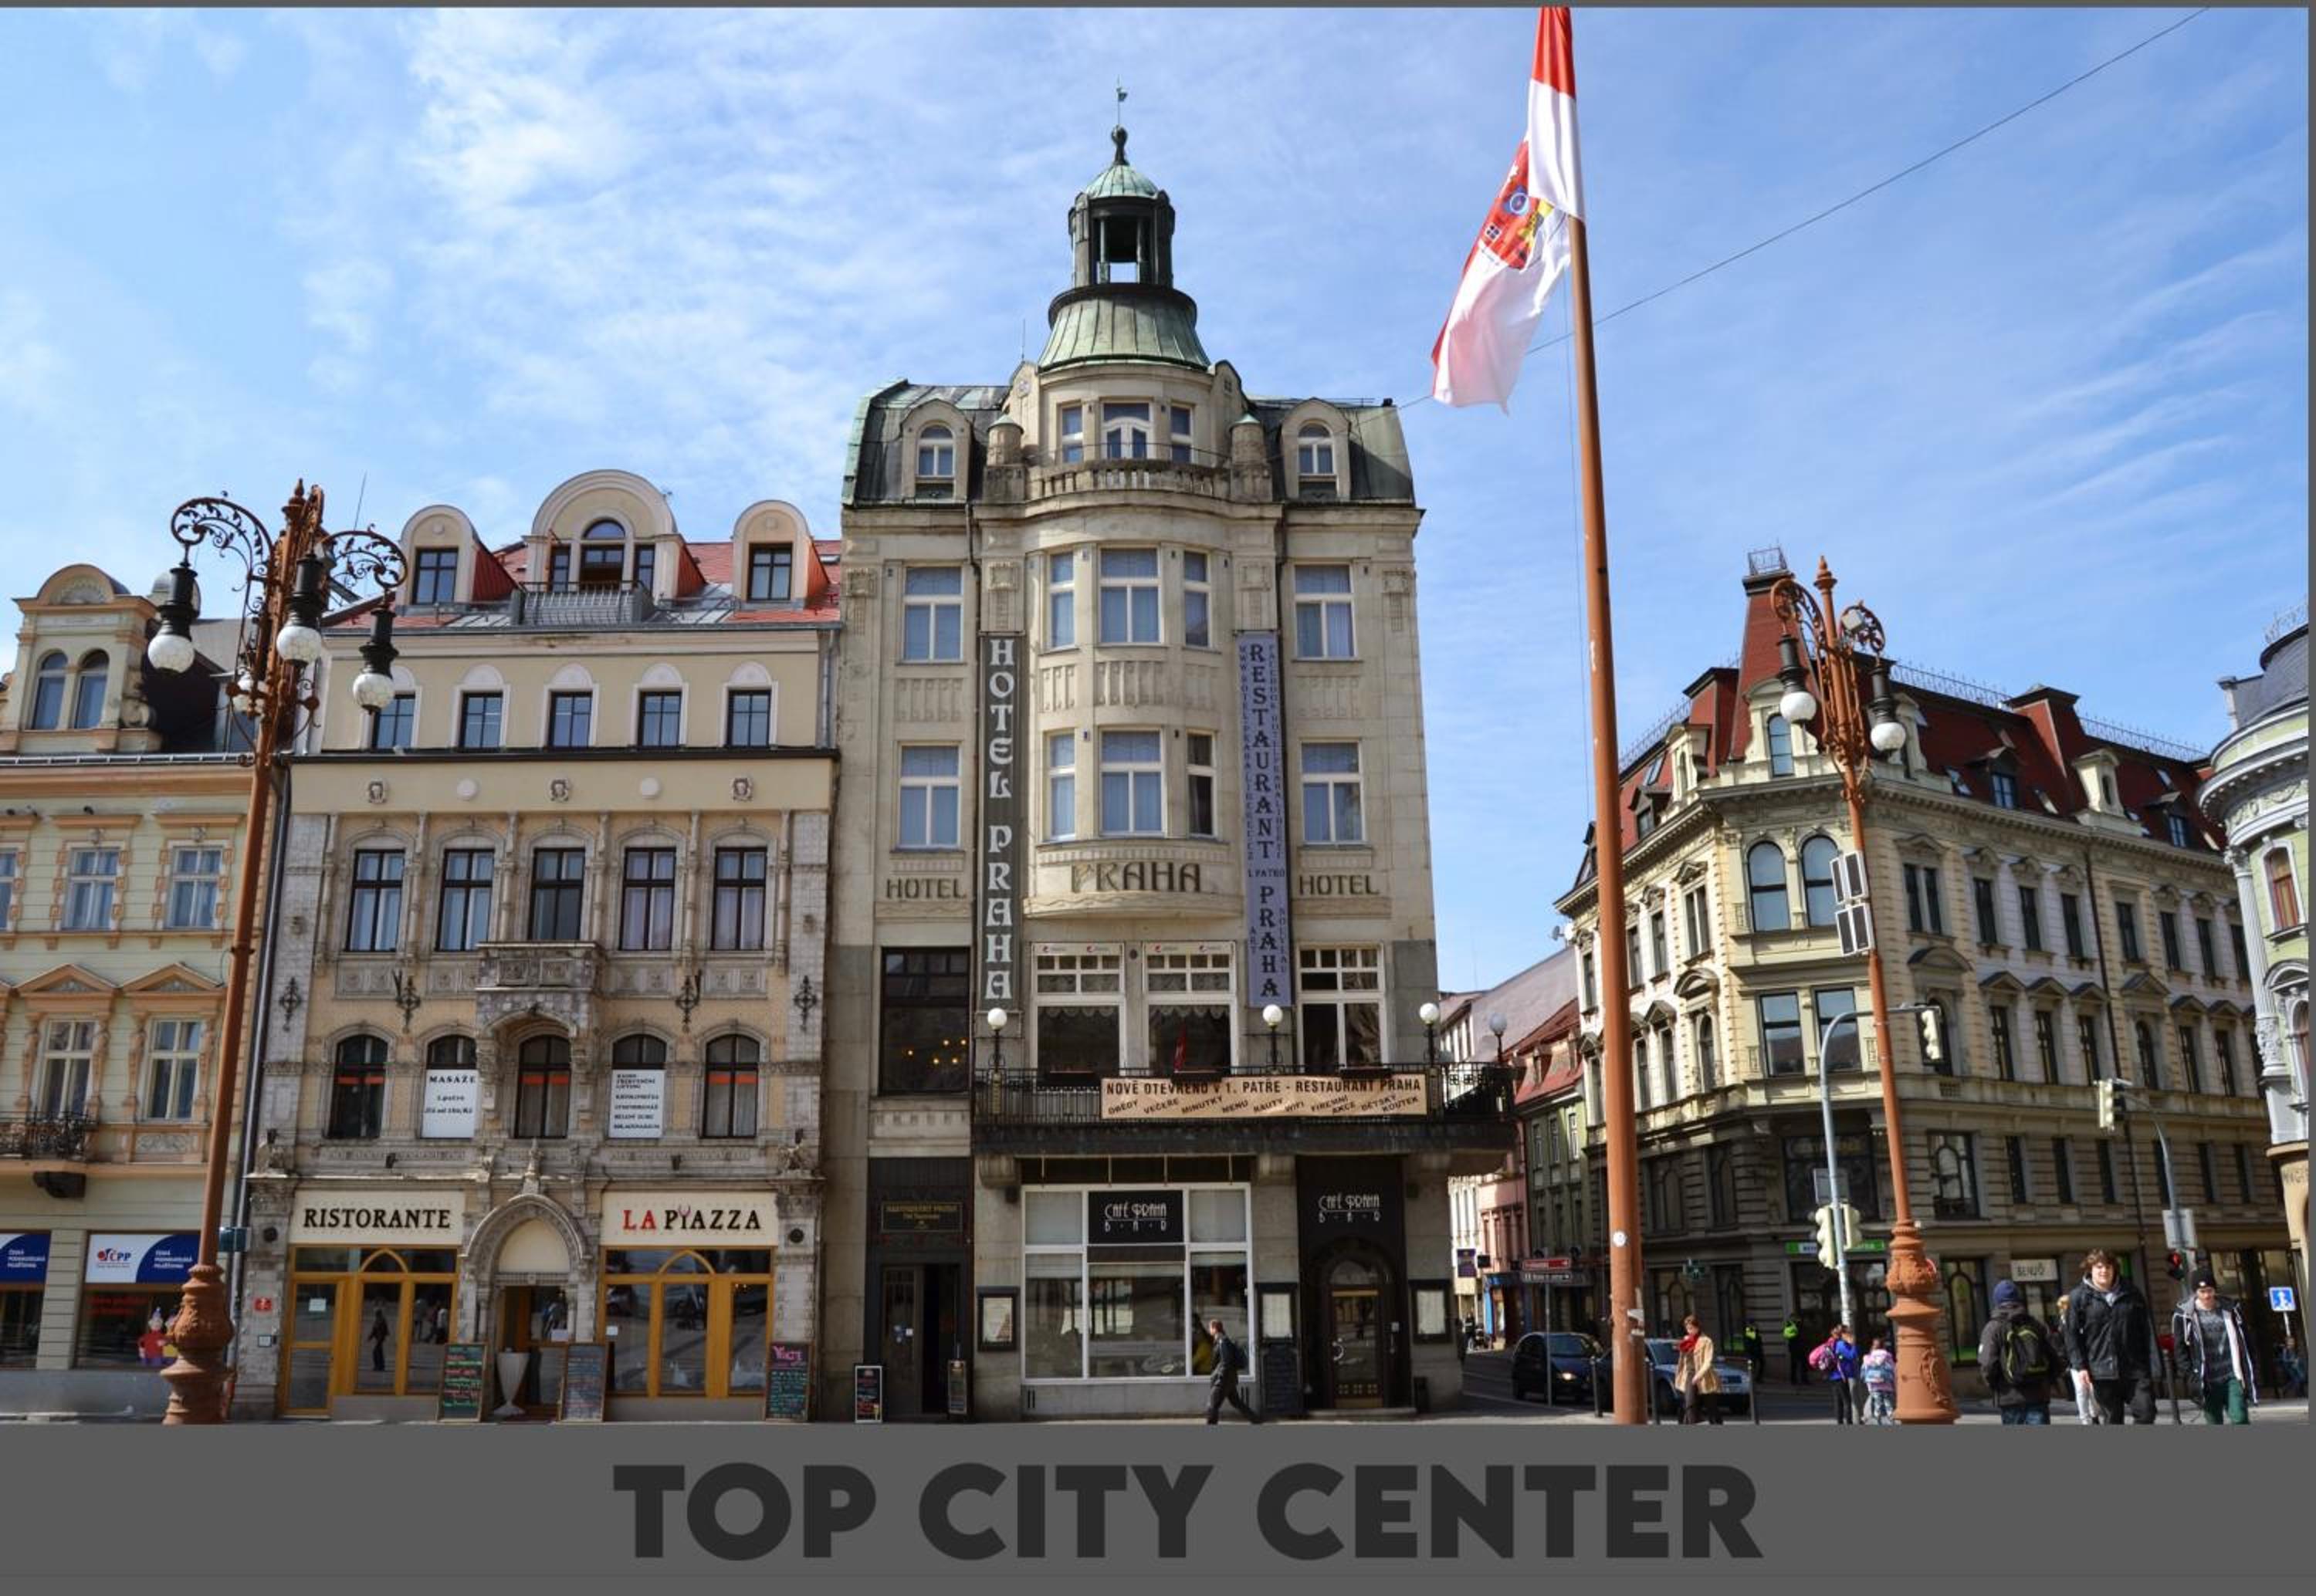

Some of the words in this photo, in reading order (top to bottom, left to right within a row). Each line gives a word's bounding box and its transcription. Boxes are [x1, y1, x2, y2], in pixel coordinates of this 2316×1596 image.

[989, 639, 1015, 799] HOTEL
[1250, 643, 1275, 859] RESTAURANT
[886, 877, 967, 899] HOTEL
[1071, 861, 1201, 894] PRAHA
[1299, 874, 1380, 895] HOTEL
[985, 825, 1013, 999] PRAHA
[1259, 885, 1281, 997] PRAHA
[1295, 1080, 1374, 1093] RESTAURANT
[1380, 1079, 1421, 1091] PRAHA
[1181, 1096, 1223, 1114] MINUTKY
[303, 1207, 451, 1229] RISTORANTE
[623, 1209, 656, 1229] LA
[664, 1206, 761, 1229] PIAZZA
